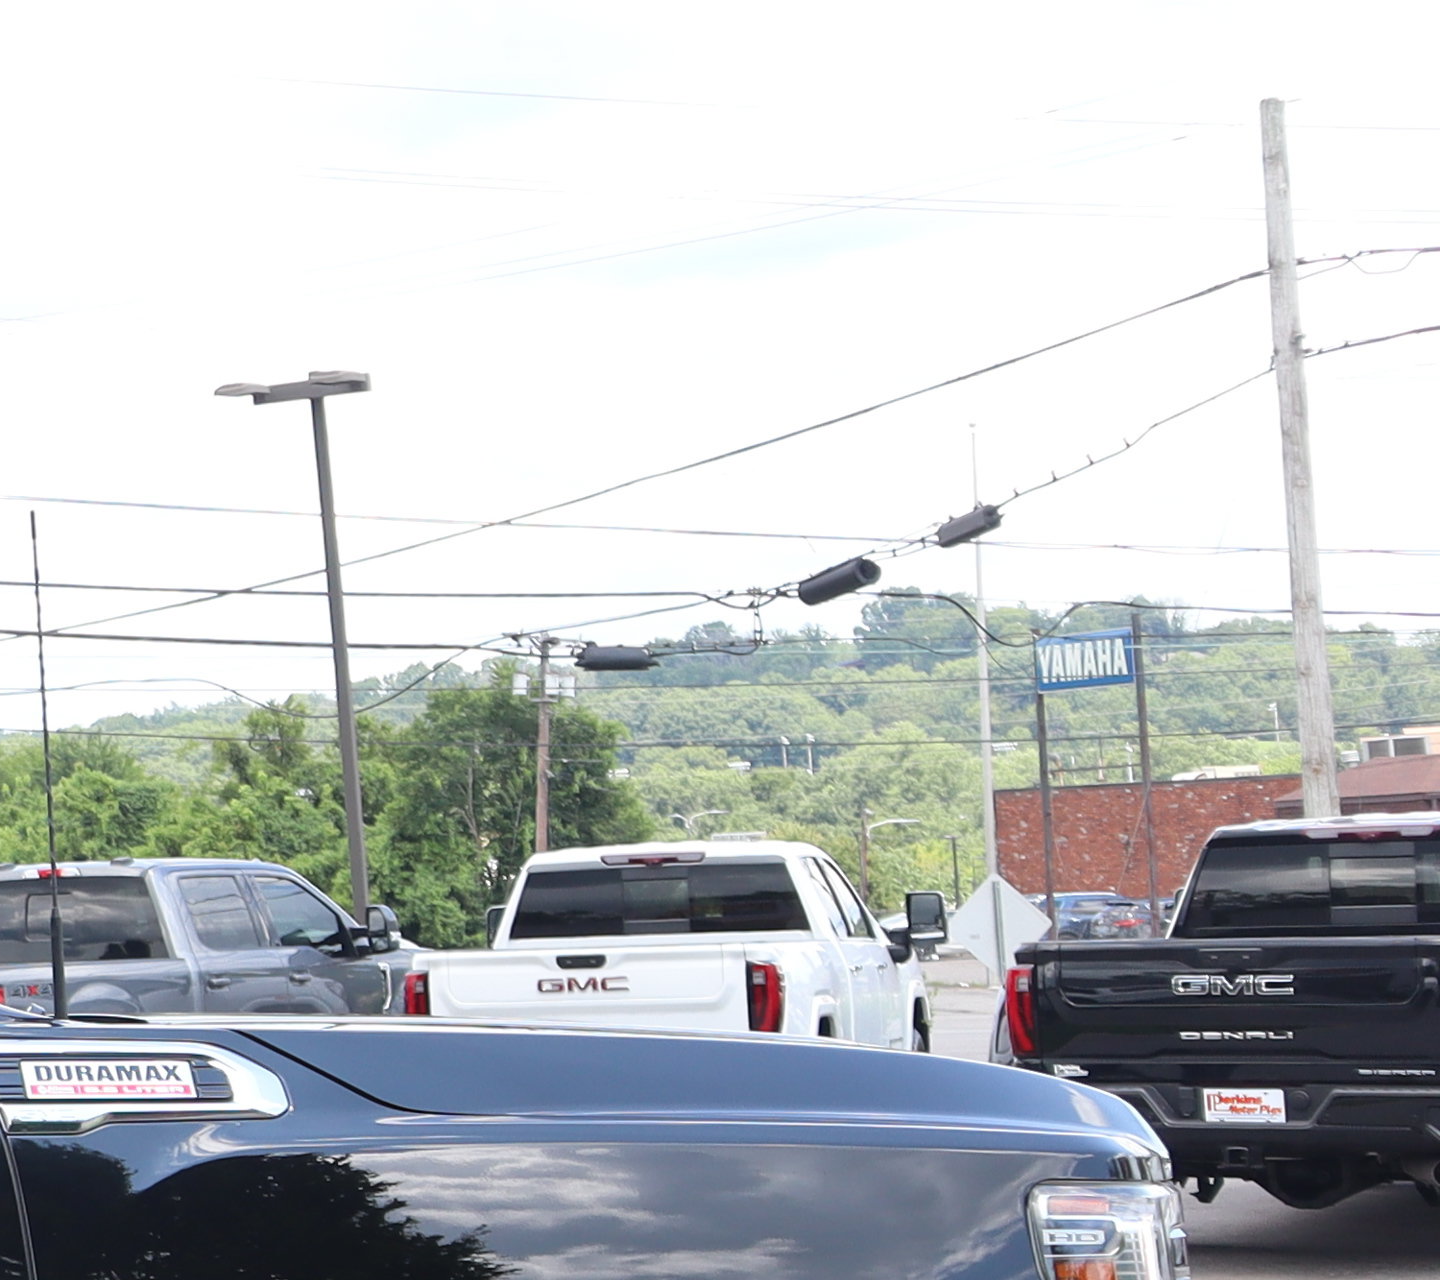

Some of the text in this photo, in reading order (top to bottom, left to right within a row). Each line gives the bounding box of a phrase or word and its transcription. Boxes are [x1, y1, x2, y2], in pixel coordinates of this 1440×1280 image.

[1038, 638, 1129, 683] YAMAHA
[537, 976, 630, 992] GMC
[1171, 975, 1294, 995] GMC
[1179, 1031, 1294, 1040] DENALI
[34, 1065, 182, 1082] DURAMAX
[1046, 1231, 1101, 1244] HD
